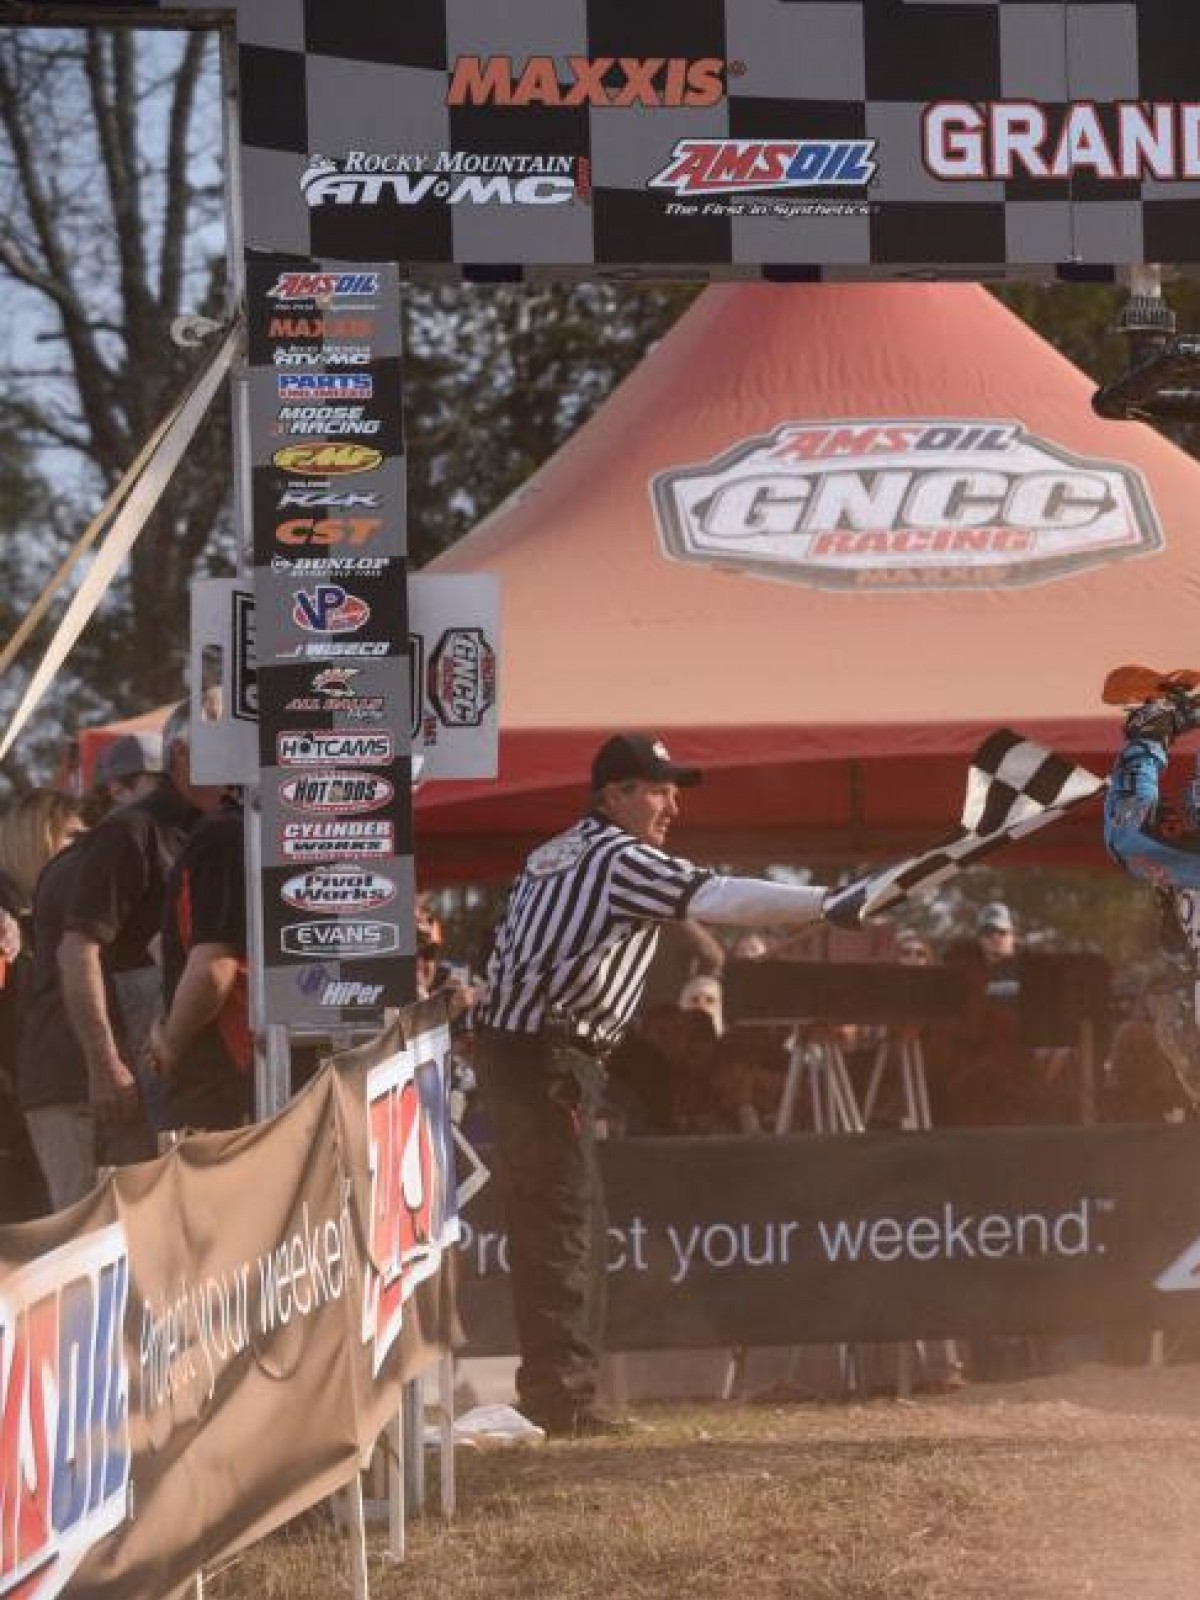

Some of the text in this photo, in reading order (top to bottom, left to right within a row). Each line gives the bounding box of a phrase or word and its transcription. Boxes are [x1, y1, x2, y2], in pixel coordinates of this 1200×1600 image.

[445, 55, 727, 107] MAXXIS
[345, 151, 574, 172] ROCKY MOUNTAIN
[648, 138, 877, 196] AMSOIL
[266, 272, 377, 299] AMSOIL
[280, 408, 364, 419] MOOSE
[771, 426, 1020, 460] AMSOIL
[700, 467, 1112, 537] GNCC
[276, 519, 384, 545] CST
[815, 530, 1034, 557] RACING
[285, 822, 389, 838] CYLINDER
[297, 926, 381, 944] EVANS
[668, 1218, 798, 1284] your
